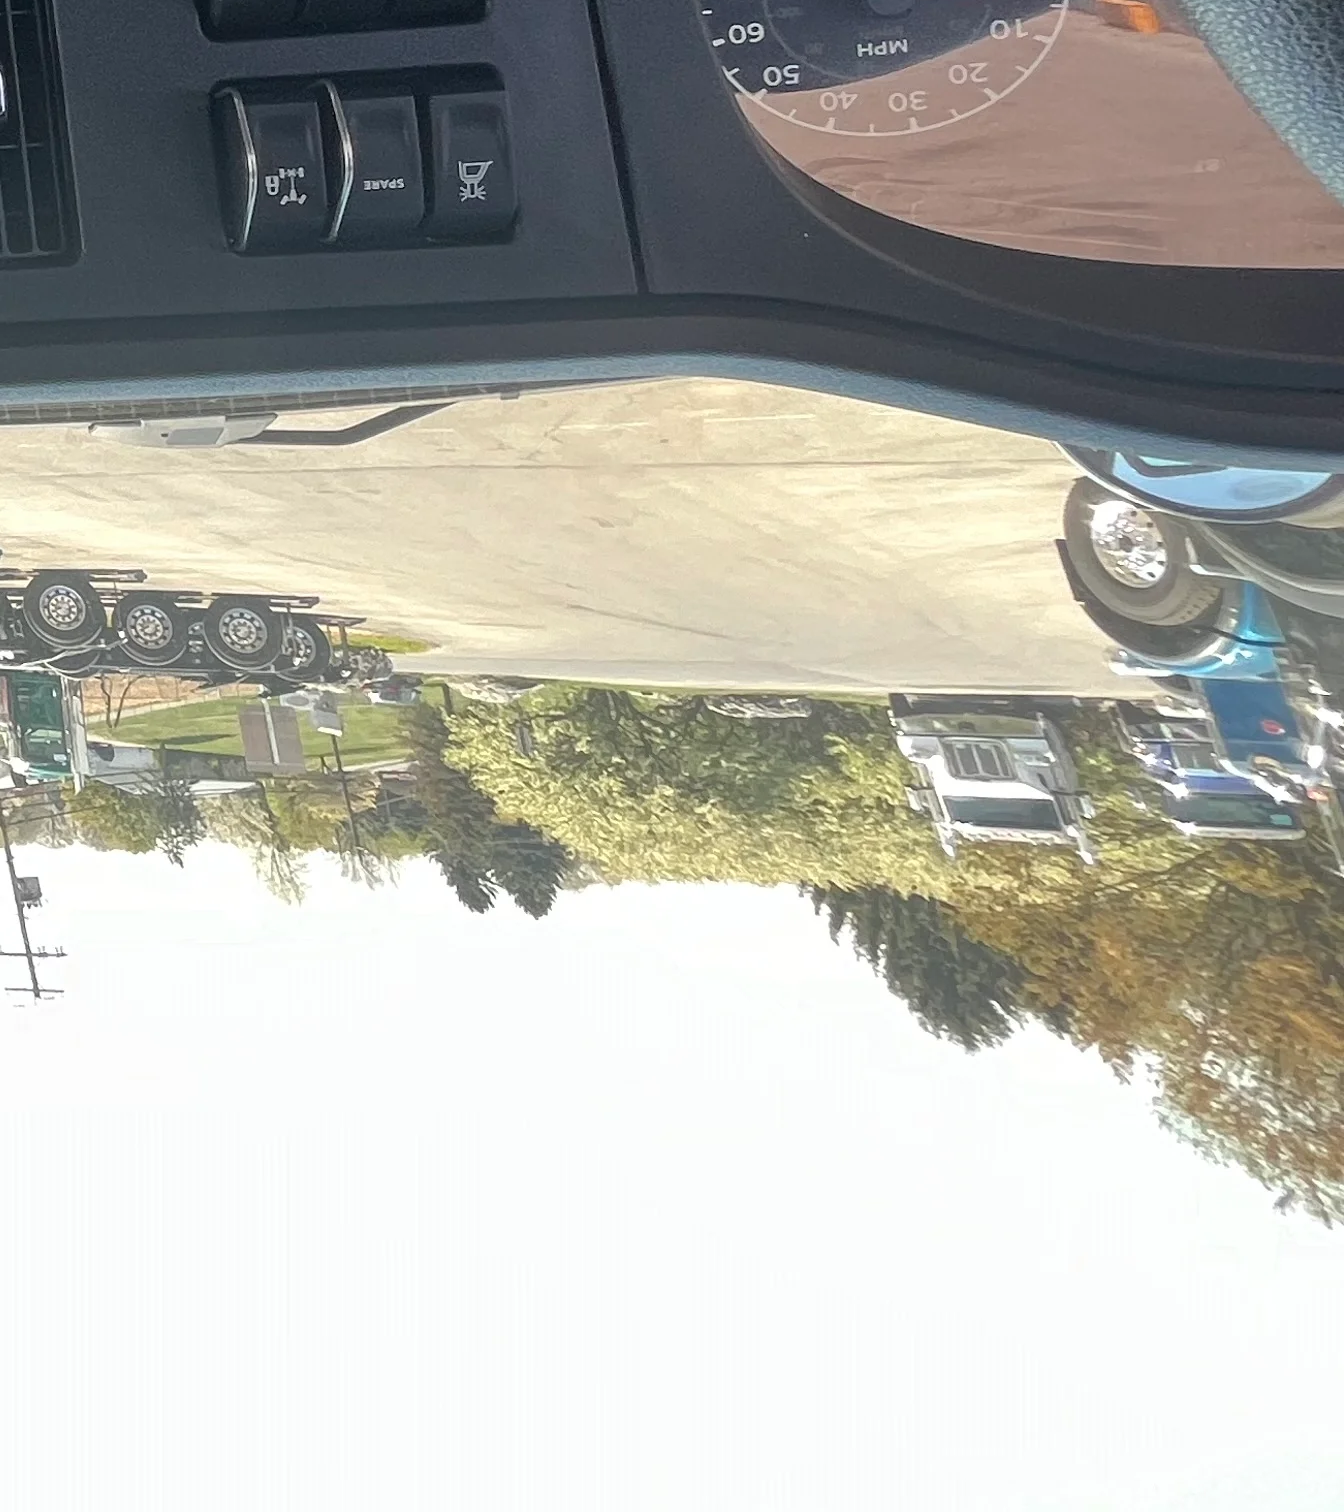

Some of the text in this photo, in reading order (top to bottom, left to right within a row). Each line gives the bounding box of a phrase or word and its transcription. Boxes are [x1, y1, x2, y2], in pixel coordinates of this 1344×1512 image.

[728, 24, 765, 44] 60
[989, 18, 1028, 39] 10
[856, 38, 908, 58] MPH
[763, 64, 800, 87] 50
[949, 63, 988, 84] 20
[820, 92, 859, 111] 40
[888, 91, 928, 112] 30
[363, 178, 405, 191] SPARE
